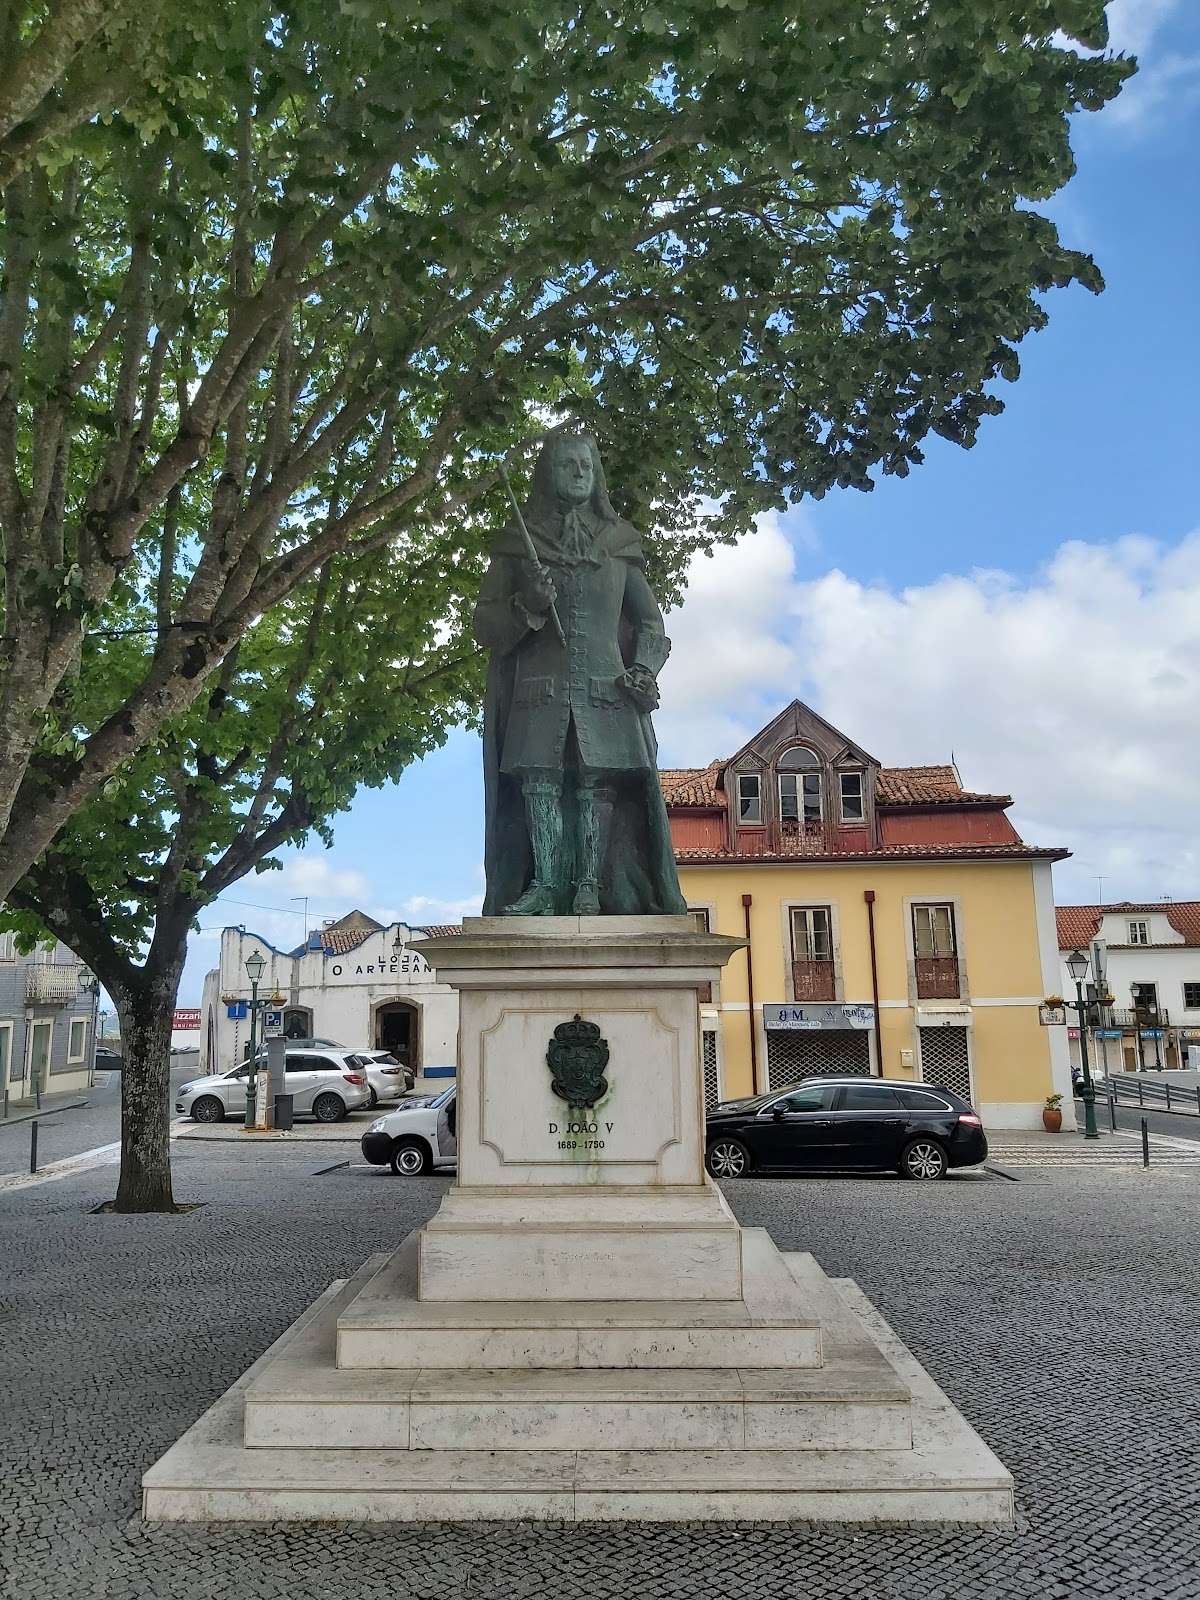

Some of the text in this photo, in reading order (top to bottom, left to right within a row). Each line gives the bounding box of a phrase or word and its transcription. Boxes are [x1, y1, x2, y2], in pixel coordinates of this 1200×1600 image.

[378, 955, 420, 964] LOJA
[332, 965, 343, 976] O
[265, 1012, 275, 1026] P
[549, 1120, 614, 1134] D. JOÃO V
